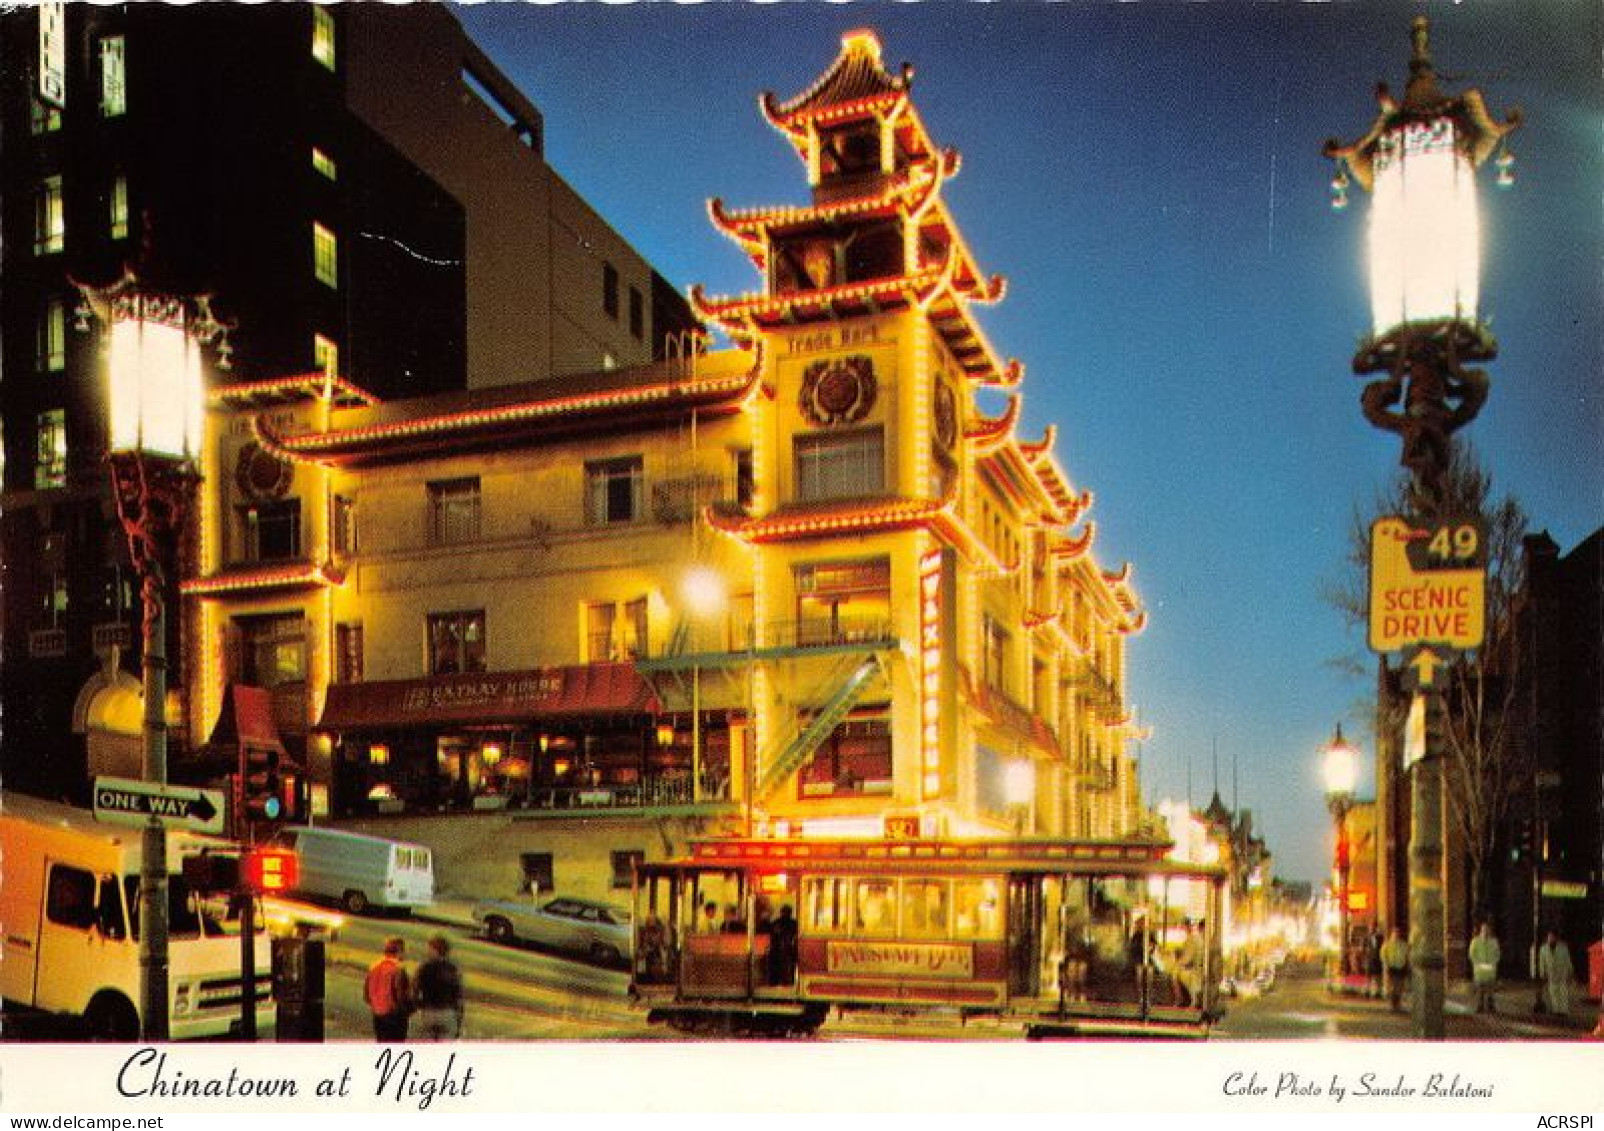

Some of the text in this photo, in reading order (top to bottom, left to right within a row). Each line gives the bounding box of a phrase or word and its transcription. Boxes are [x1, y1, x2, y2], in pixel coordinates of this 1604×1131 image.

[1428, 524, 1478, 560] 49
[1383, 587, 1469, 612] SCENIC
[1383, 613, 1469, 638] DRIVE
[101, 791, 188, 816] ONE WAY
